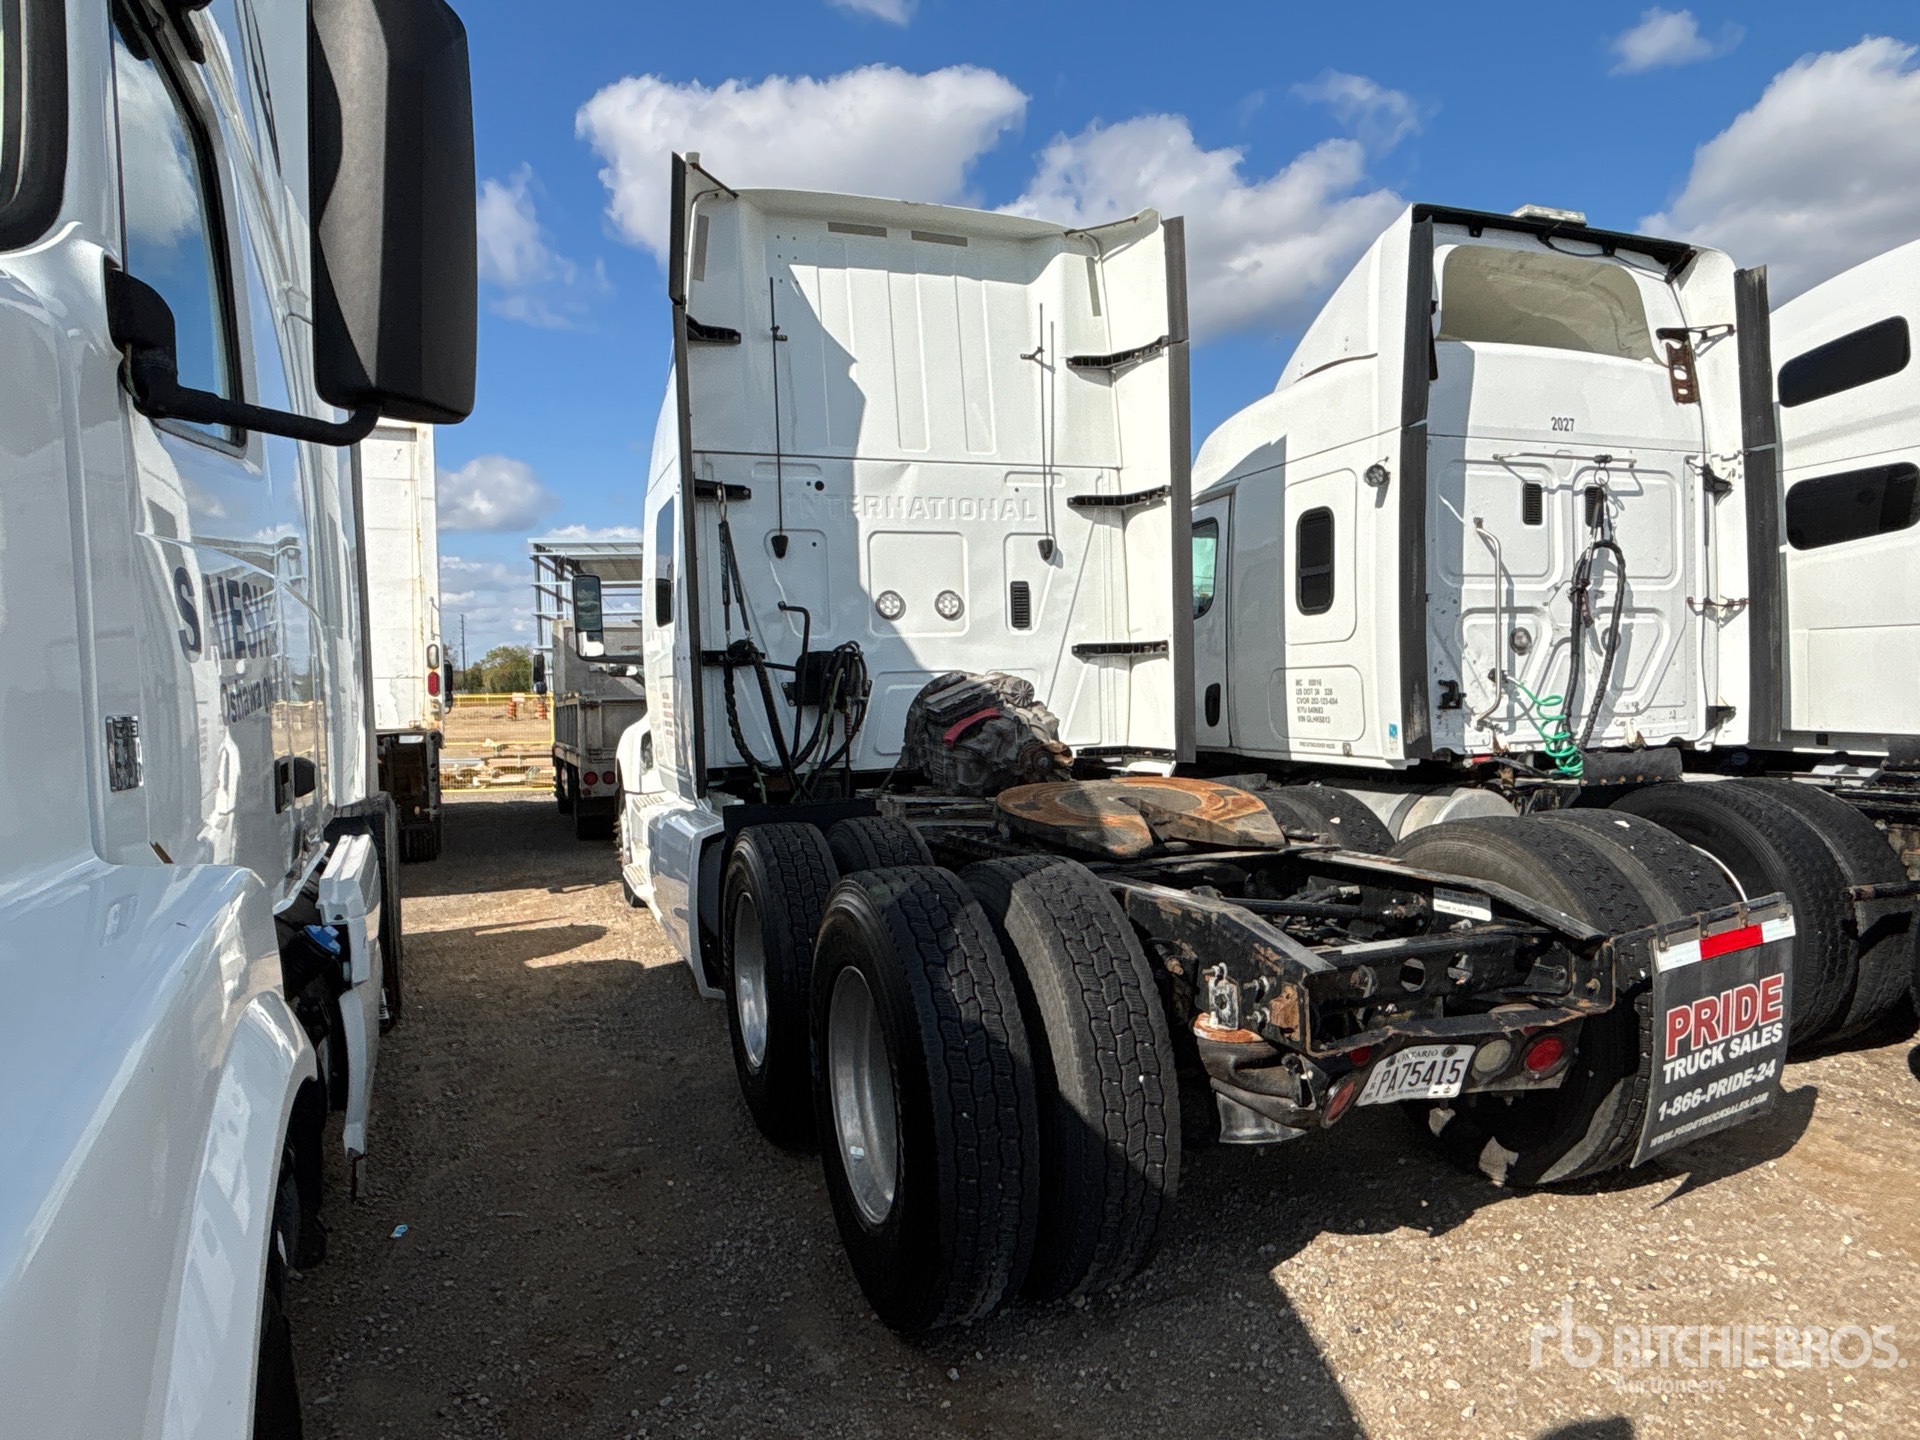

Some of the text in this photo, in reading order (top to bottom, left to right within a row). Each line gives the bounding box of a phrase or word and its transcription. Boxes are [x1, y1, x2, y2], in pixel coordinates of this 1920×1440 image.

[1551, 416, 1575, 432] 2027
[787, 493, 1037, 521] INTERNATIONAL
[1665, 973, 1784, 1060] PRIDE
[1376, 1058, 1465, 1097] PA75415
[1663, 1023, 1783, 1084] TRUCK SALES
[1658, 1058, 1776, 1122] 1-866-PRIDE-24
